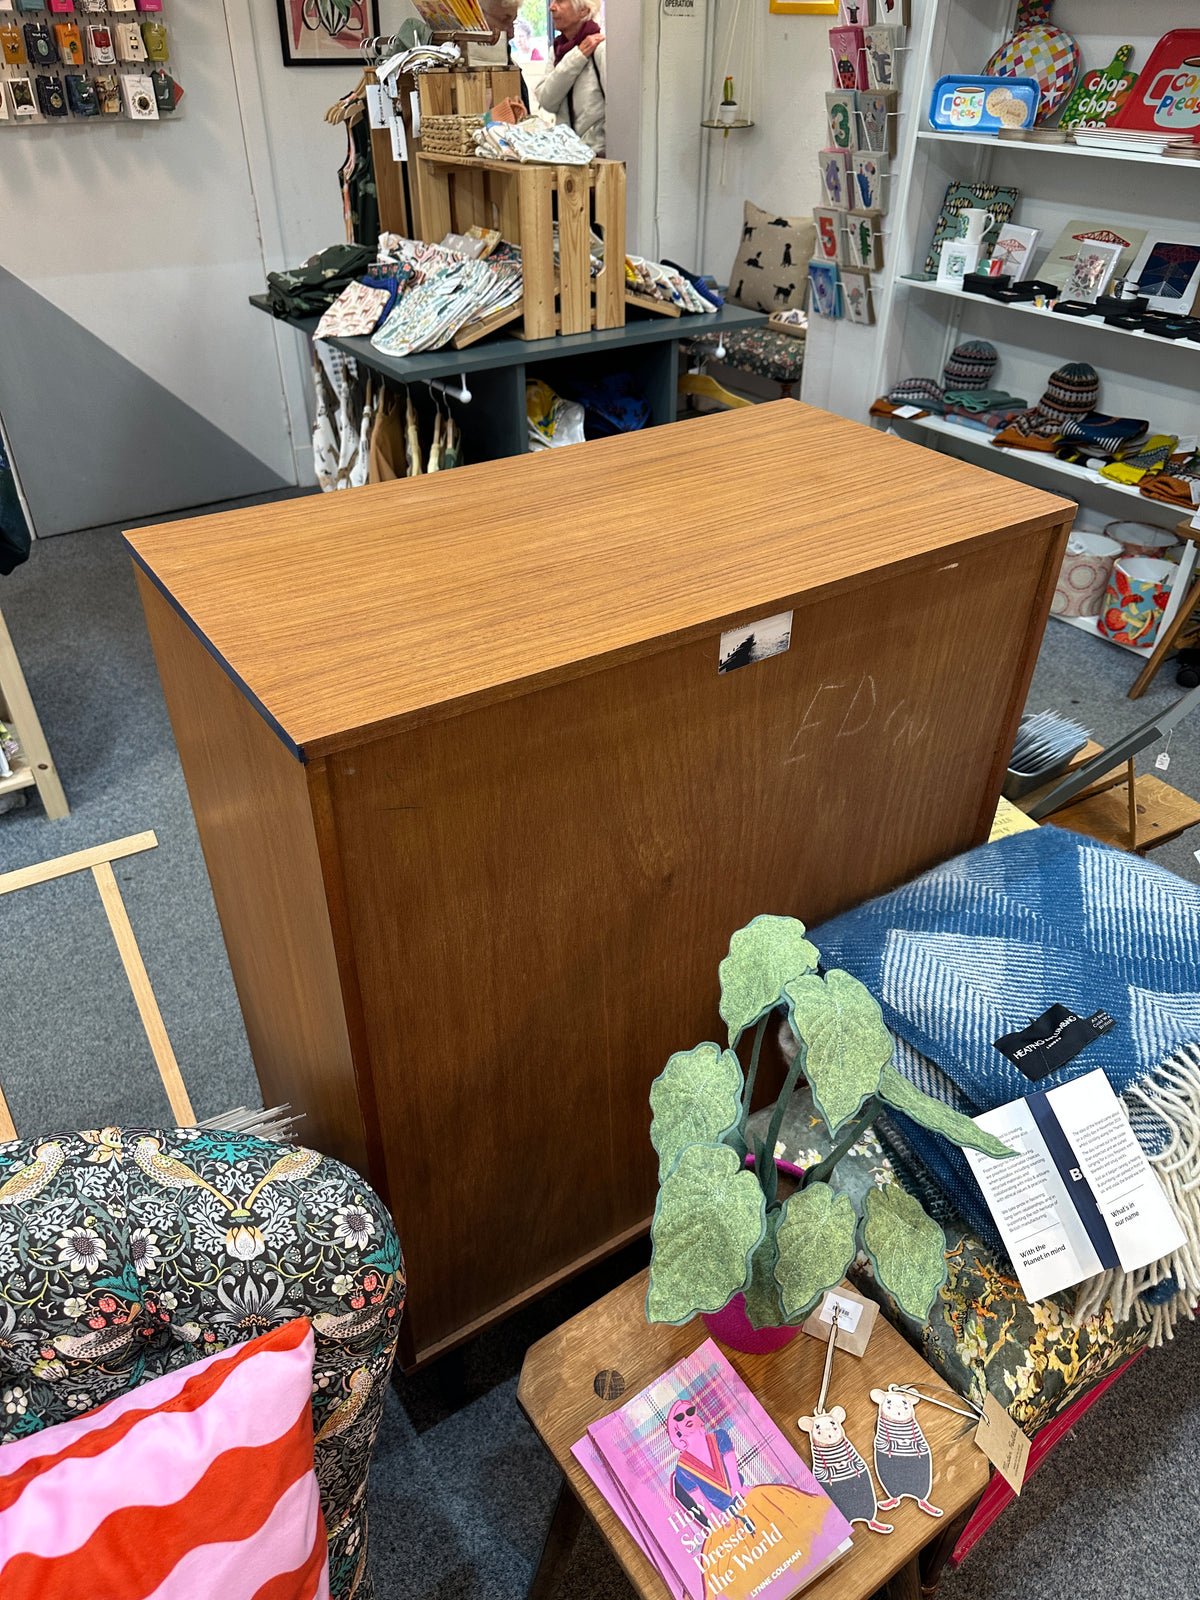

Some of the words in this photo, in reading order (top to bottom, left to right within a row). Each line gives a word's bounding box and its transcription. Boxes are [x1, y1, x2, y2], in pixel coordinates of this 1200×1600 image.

[1089, 74, 1128, 97] chop
[1079, 94, 1117, 118] chop
[1013, 1039, 1046, 1060] HEATING
[1110, 1205, 1130, 1218] What's
[1115, 1218, 1125, 1227] our
[1125, 1210, 1139, 1221] name
[1020, 1247, 1036, 1259] With
[1035, 1243, 1046, 1253] the
[1023, 1255, 1045, 1268] Planet
[1044, 1251, 1051, 1259] in
[1050, 1244, 1066, 1256] mind
[668, 1502, 706, 1534] How
[680, 1491, 748, 1553] Scotland
[692, 1515, 756, 1574] Dressed
[707, 1568, 736, 1595] the
[732, 1522, 783, 1571] World
[750, 1577, 772, 1598] LYNNE
[771, 1549, 802, 1579] COLEMAN
